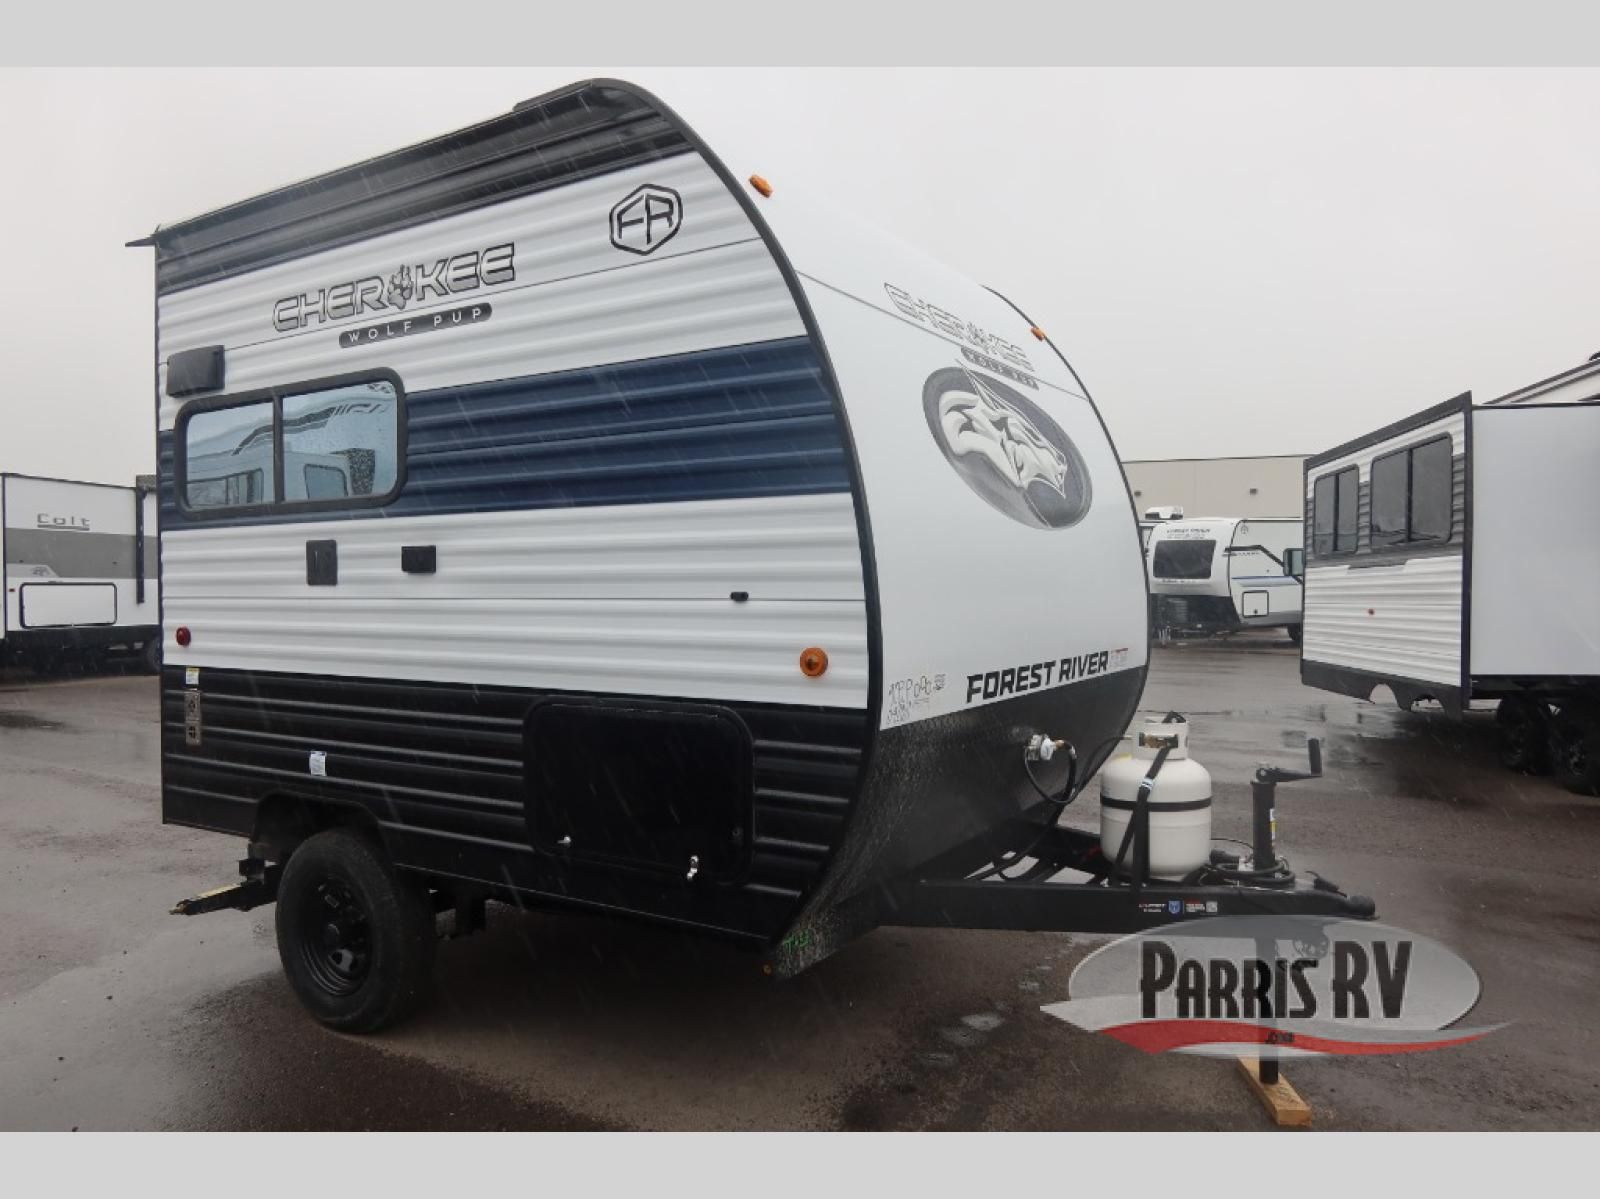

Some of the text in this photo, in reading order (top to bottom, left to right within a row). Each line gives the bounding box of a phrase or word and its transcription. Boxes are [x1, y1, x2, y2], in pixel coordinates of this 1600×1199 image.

[349, 307, 482, 343] WOLF PUP
[37, 513, 90, 527] Colt
[966, 660, 1056, 703] FOREST
[1058, 650, 1109, 682] RIVER
